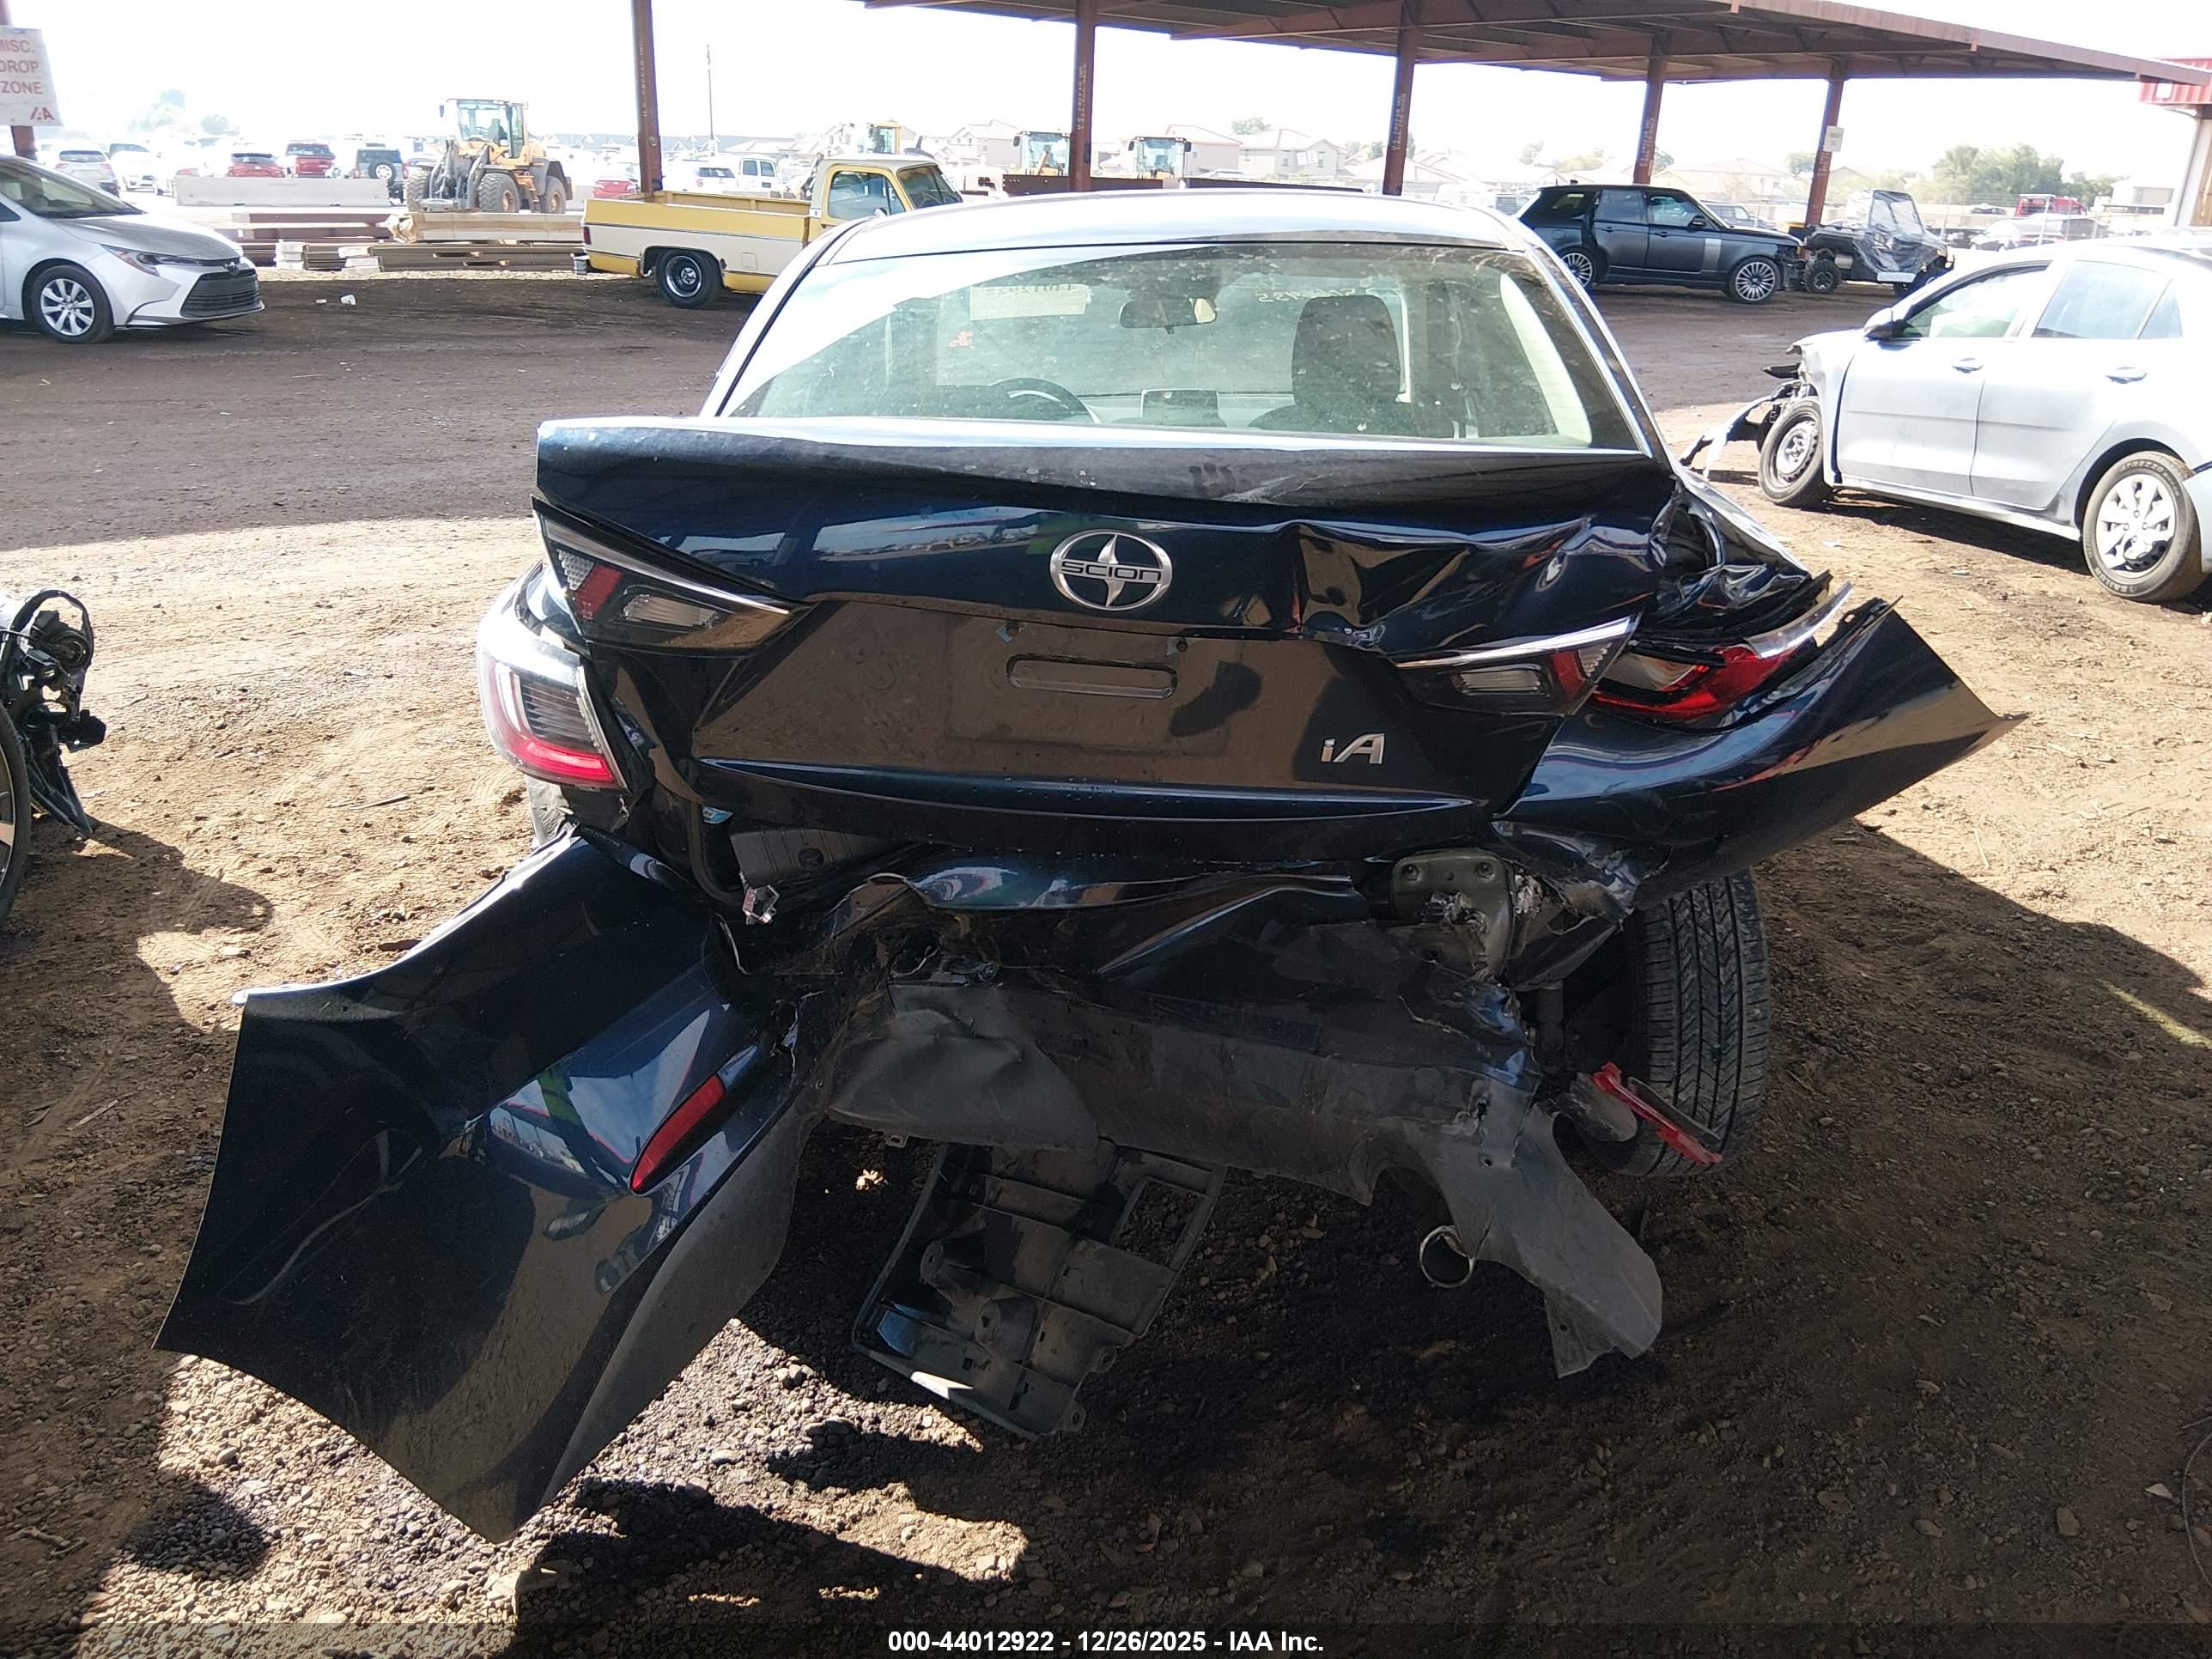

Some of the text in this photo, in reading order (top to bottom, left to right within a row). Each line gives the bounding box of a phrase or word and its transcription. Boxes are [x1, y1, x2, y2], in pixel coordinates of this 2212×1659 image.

[0, 59, 40, 73] DROP
[1, 80, 43, 94] ZONE
[1320, 732, 1386, 764] iA
